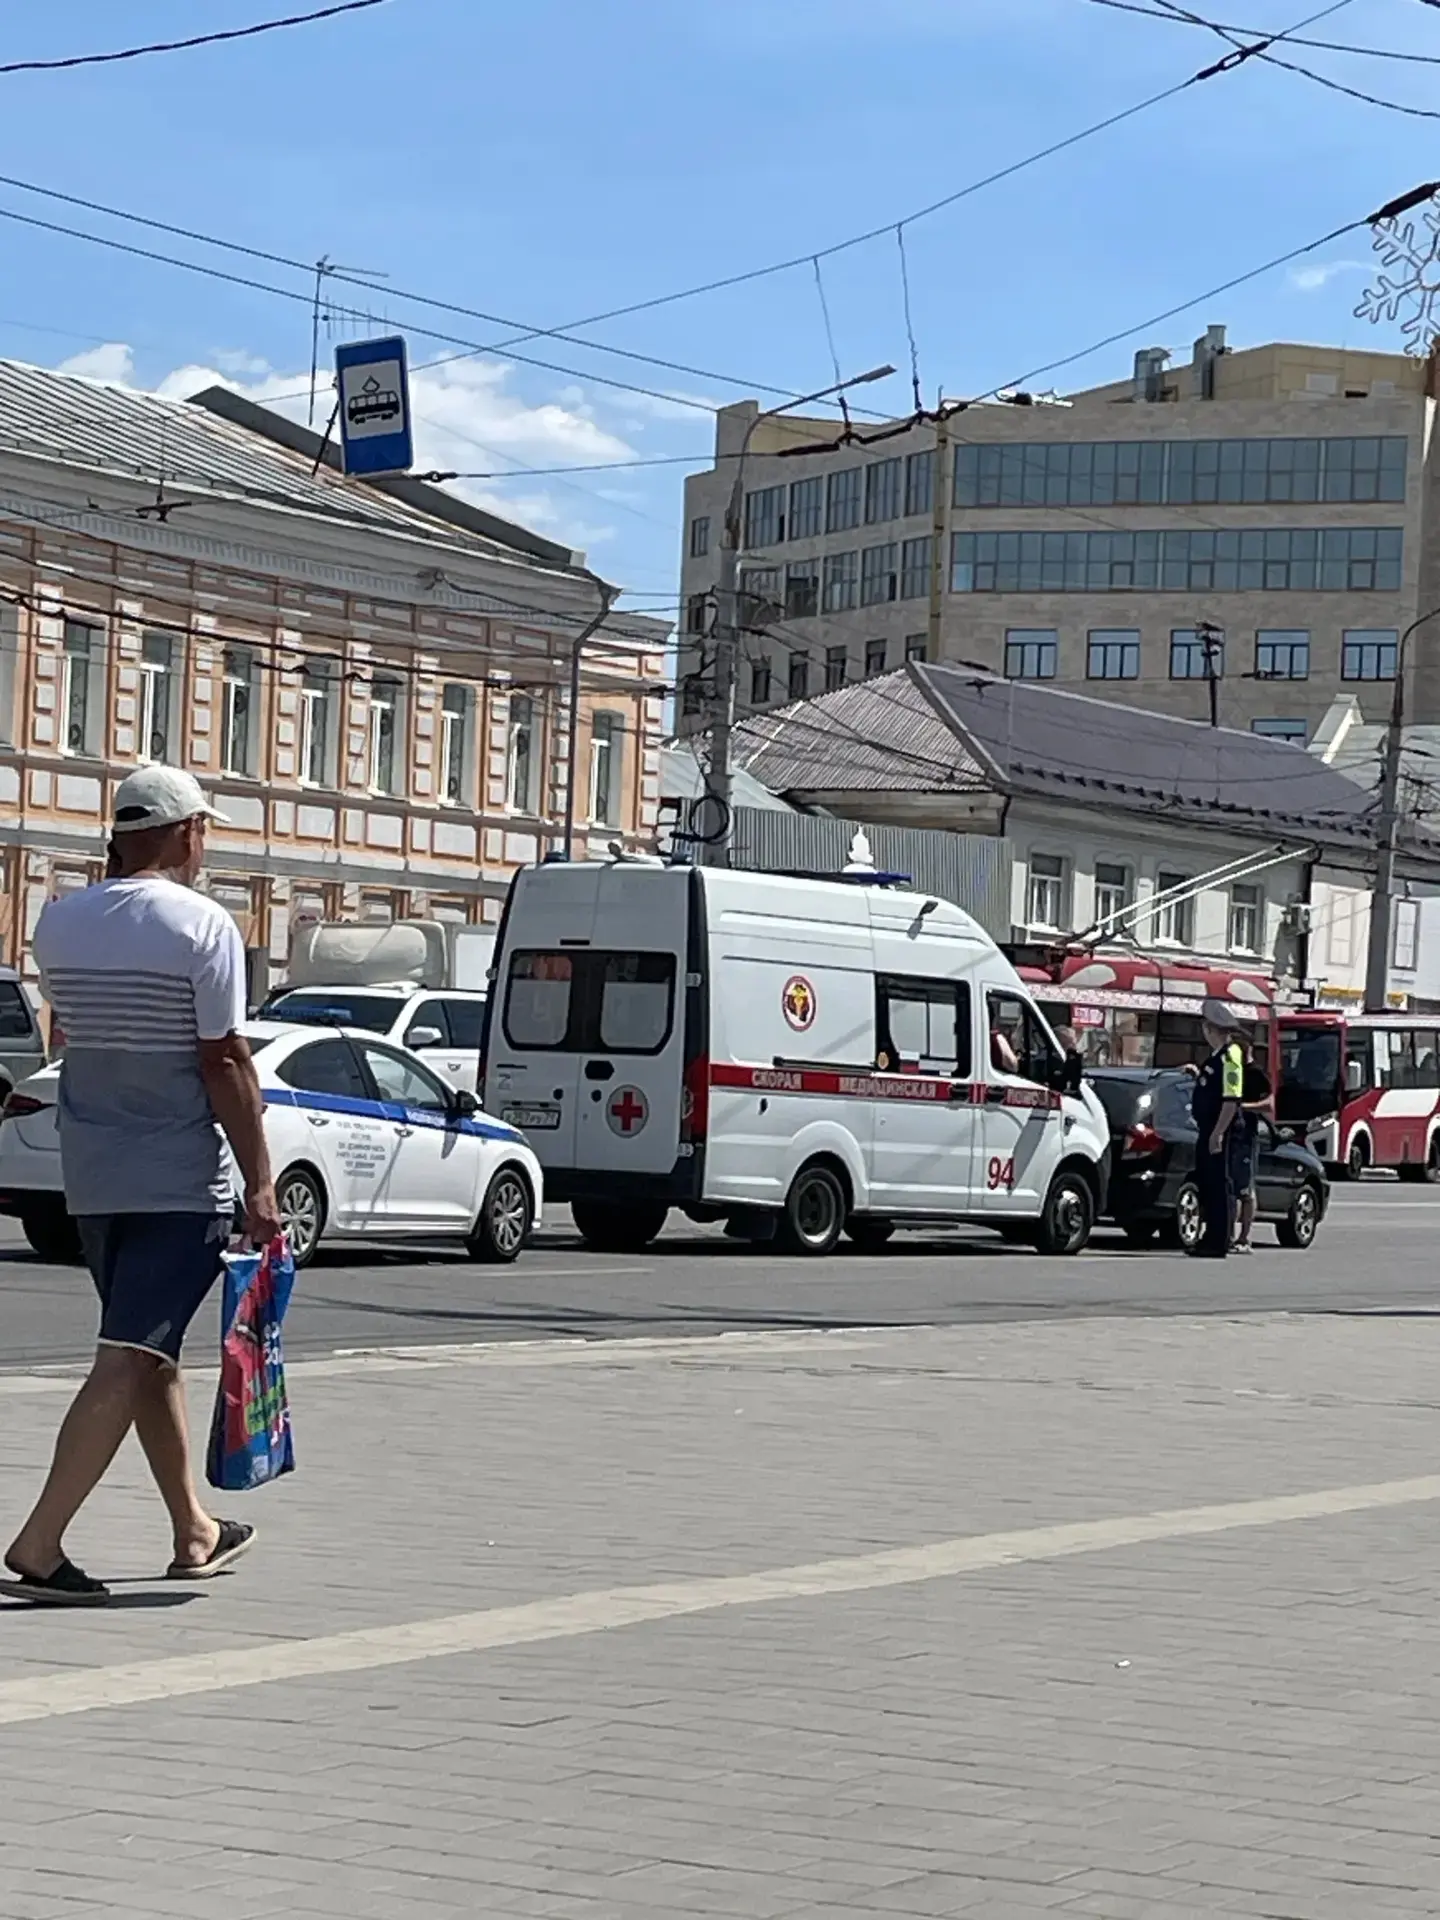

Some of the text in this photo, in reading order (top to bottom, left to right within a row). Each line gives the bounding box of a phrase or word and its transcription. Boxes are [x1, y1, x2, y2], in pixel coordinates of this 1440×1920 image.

[752, 1071, 803, 1090] СКОРАЯ
[838, 1077, 937, 1098] МЕДИЦИНСКАЯ
[987, 1156, 1015, 1190] 94
